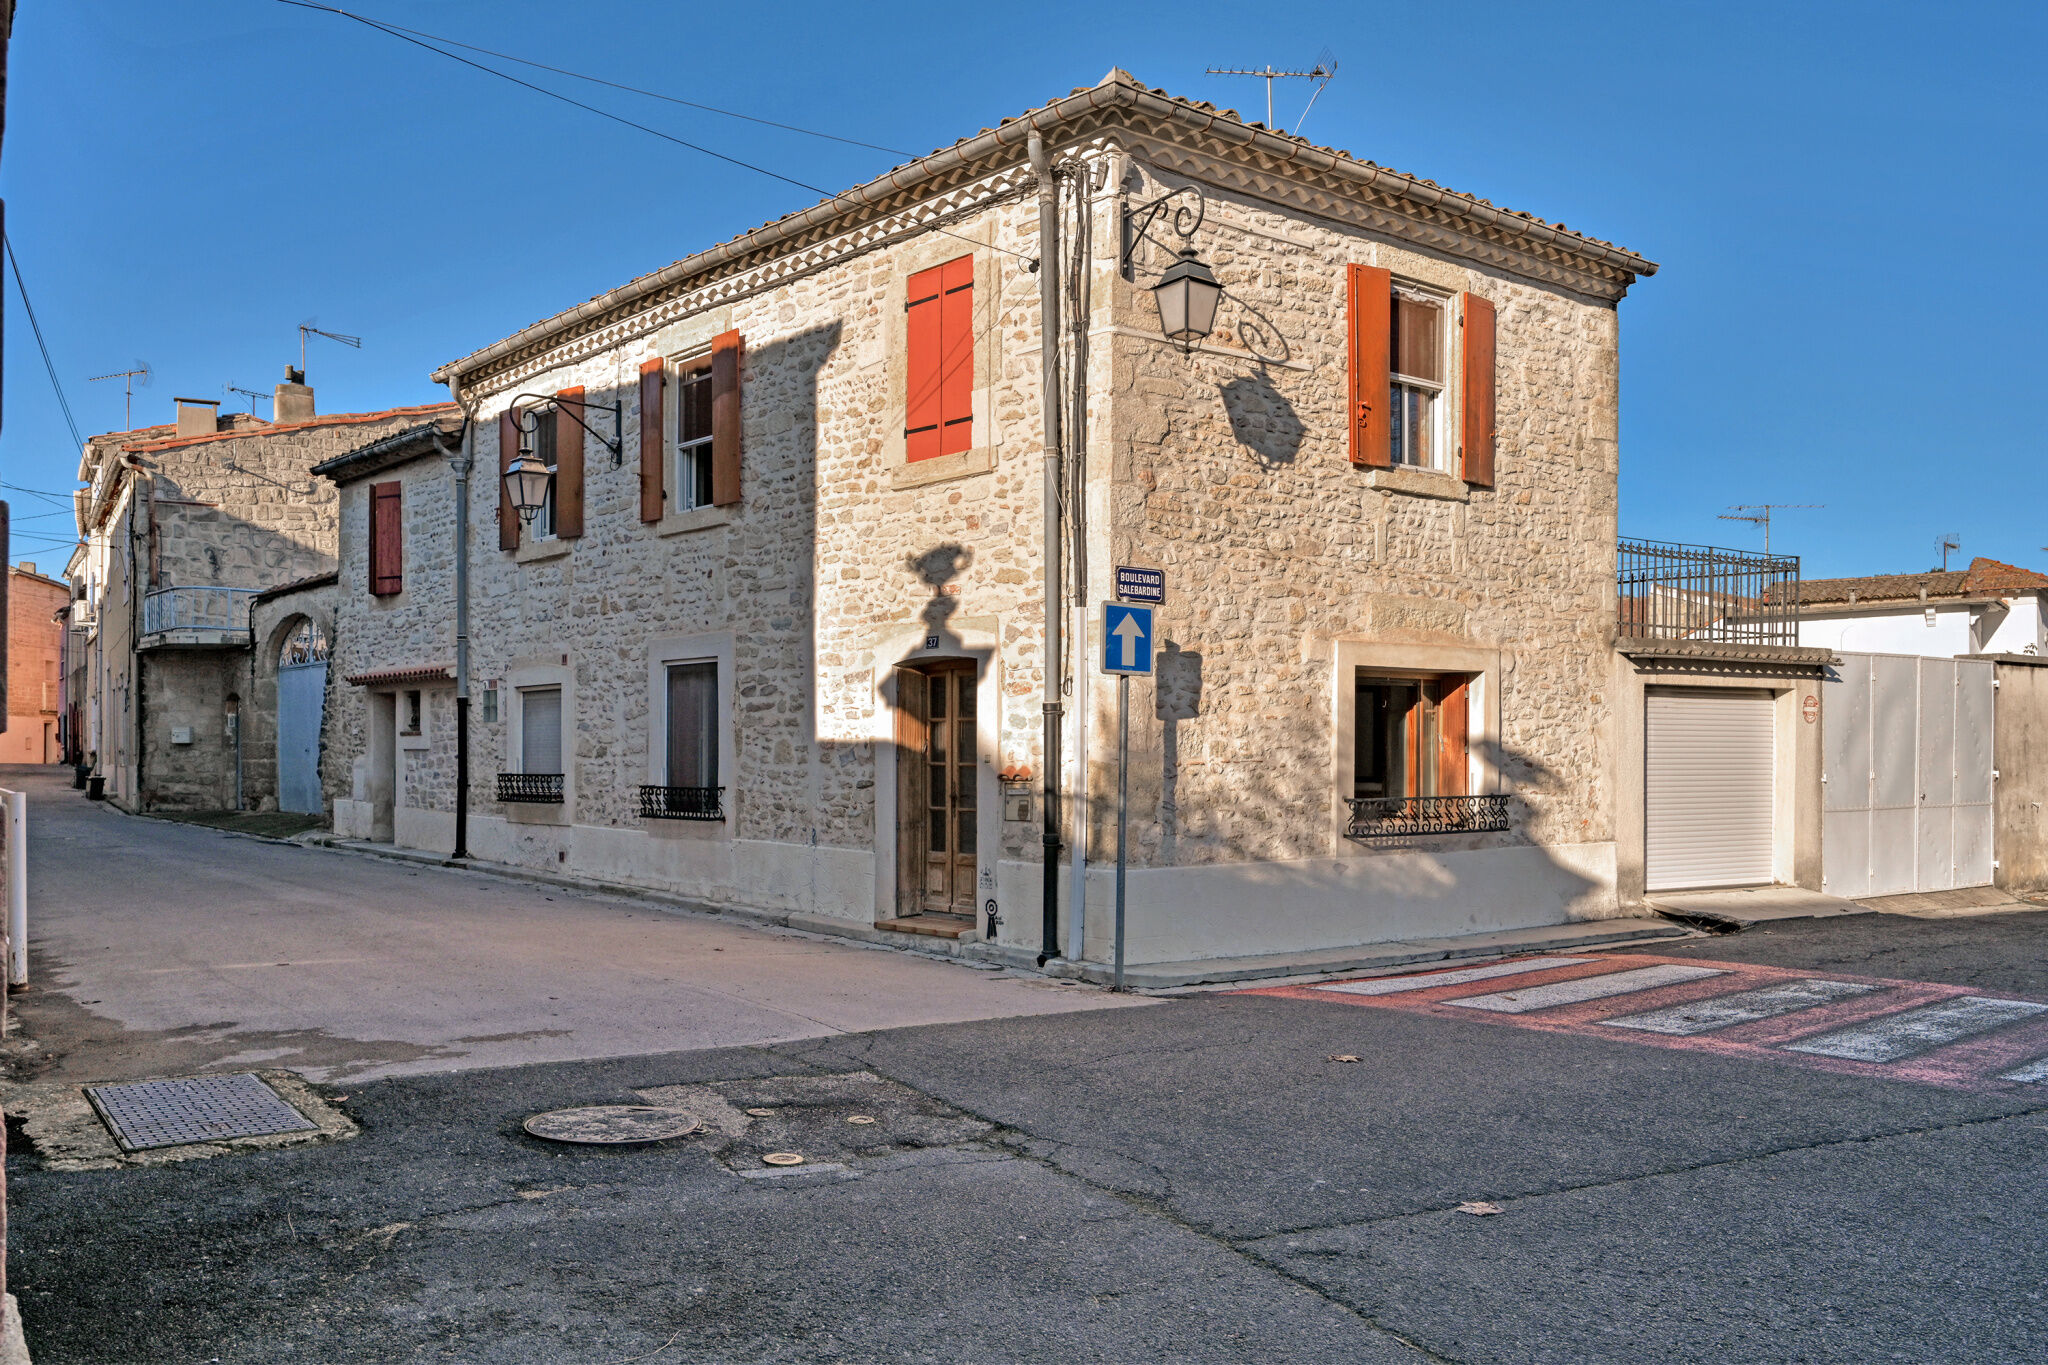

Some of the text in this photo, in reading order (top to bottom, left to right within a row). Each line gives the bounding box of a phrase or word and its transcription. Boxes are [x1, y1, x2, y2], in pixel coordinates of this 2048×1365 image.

[1120, 572, 1160, 585] BOULEVARD
[1119, 584, 1161, 597] SALEBARDINE
[927, 637, 937, 647] 37
